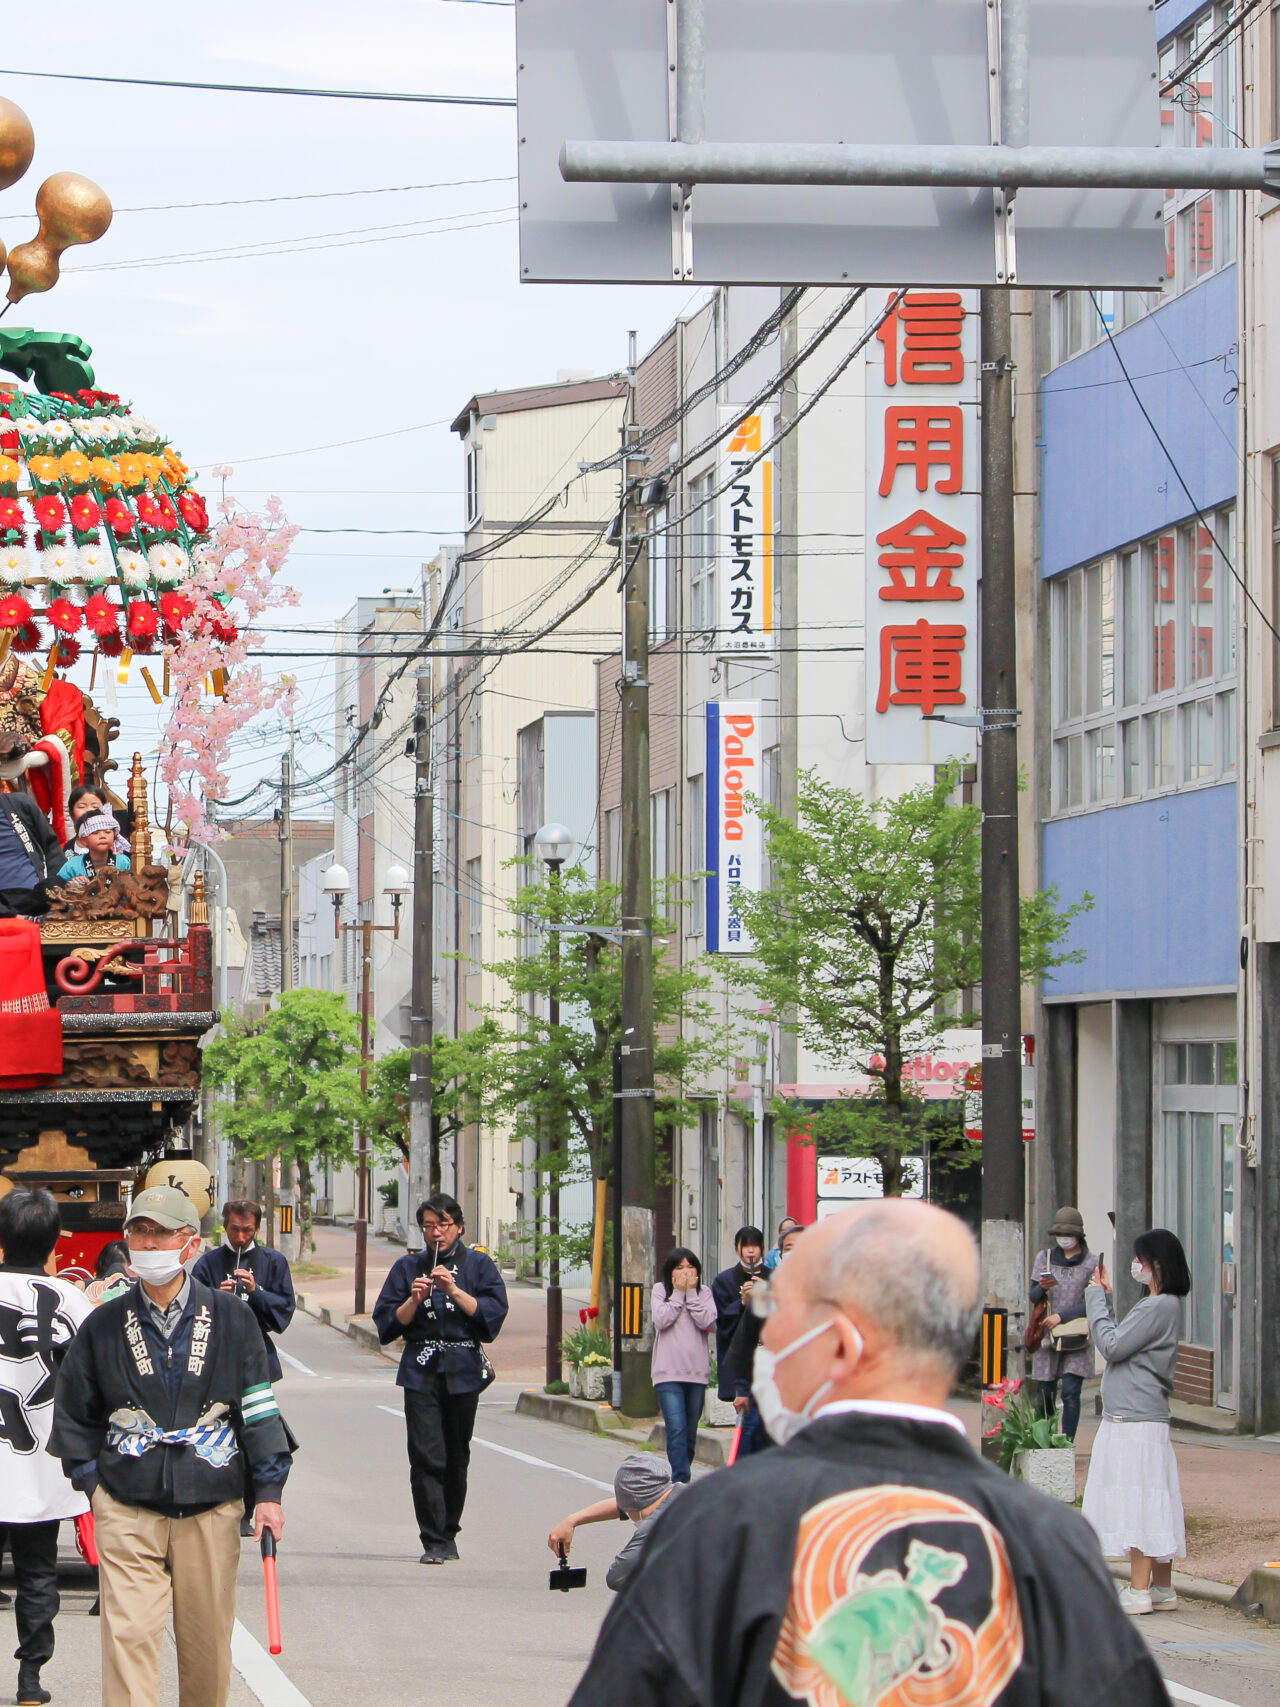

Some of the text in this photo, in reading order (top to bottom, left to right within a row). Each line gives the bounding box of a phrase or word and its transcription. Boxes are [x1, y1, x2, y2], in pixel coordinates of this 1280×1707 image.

[730, 460, 755, 634] アストモスガス
[876, 291, 967, 715] 信用金庫
[724, 715, 755, 841] Paloma
[11, 812, 34, 853] 上新田町
[124, 1309, 155, 1376] 上新田町
[187, 1305, 212, 1376] 上新田町
